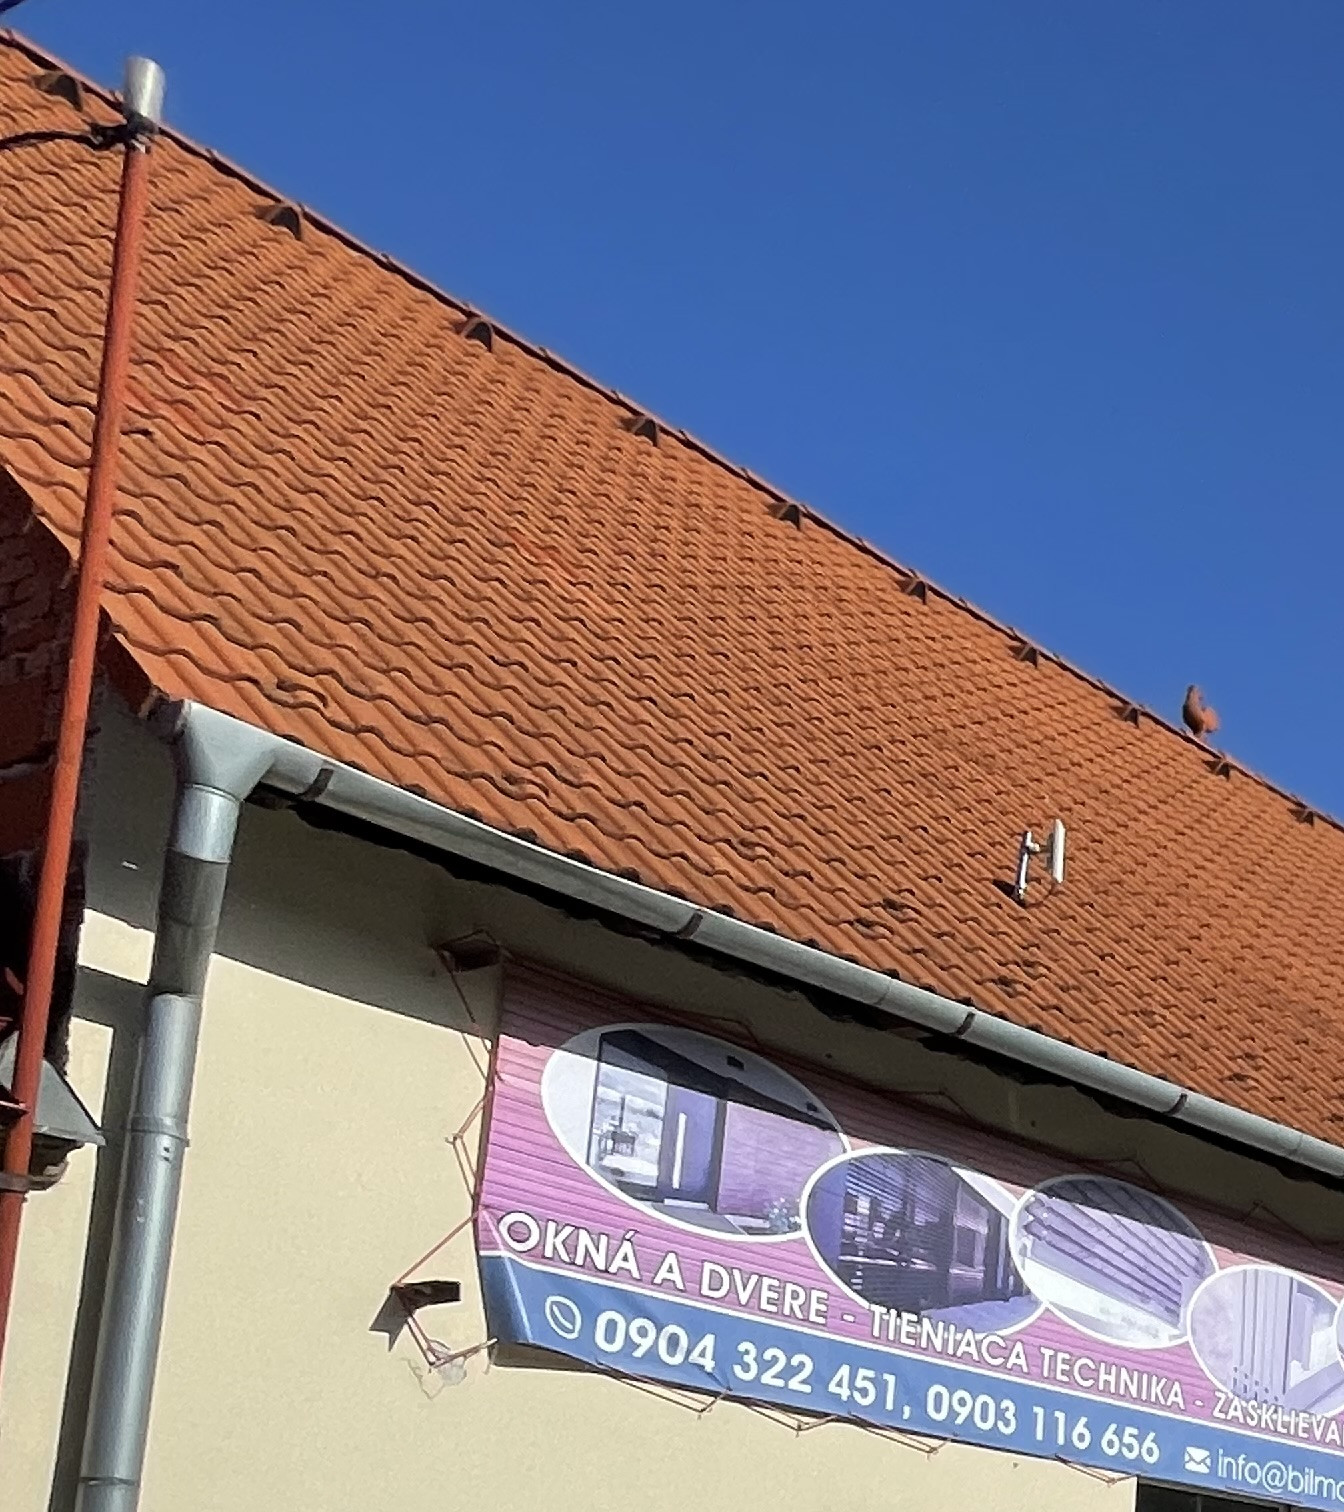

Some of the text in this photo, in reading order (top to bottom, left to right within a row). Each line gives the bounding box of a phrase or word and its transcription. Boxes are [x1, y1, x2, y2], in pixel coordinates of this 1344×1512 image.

[498, 1211, 642, 1280] OKNÁ
[652, 1251, 686, 1291] A
[700, 1267, 828, 1325] DVERE
[870, 1304, 1029, 1374] TIENIACA
[1040, 1347, 1185, 1410] TECHNIKA
[594, 1310, 717, 1374] 0904
[733, 1341, 813, 1394] 322
[828, 1365, 911, 1420] 451,
[926, 1384, 1017, 1435] 0903
[1033, 1406, 1092, 1450] 116
[1101, 1422, 1160, 1464] 656
